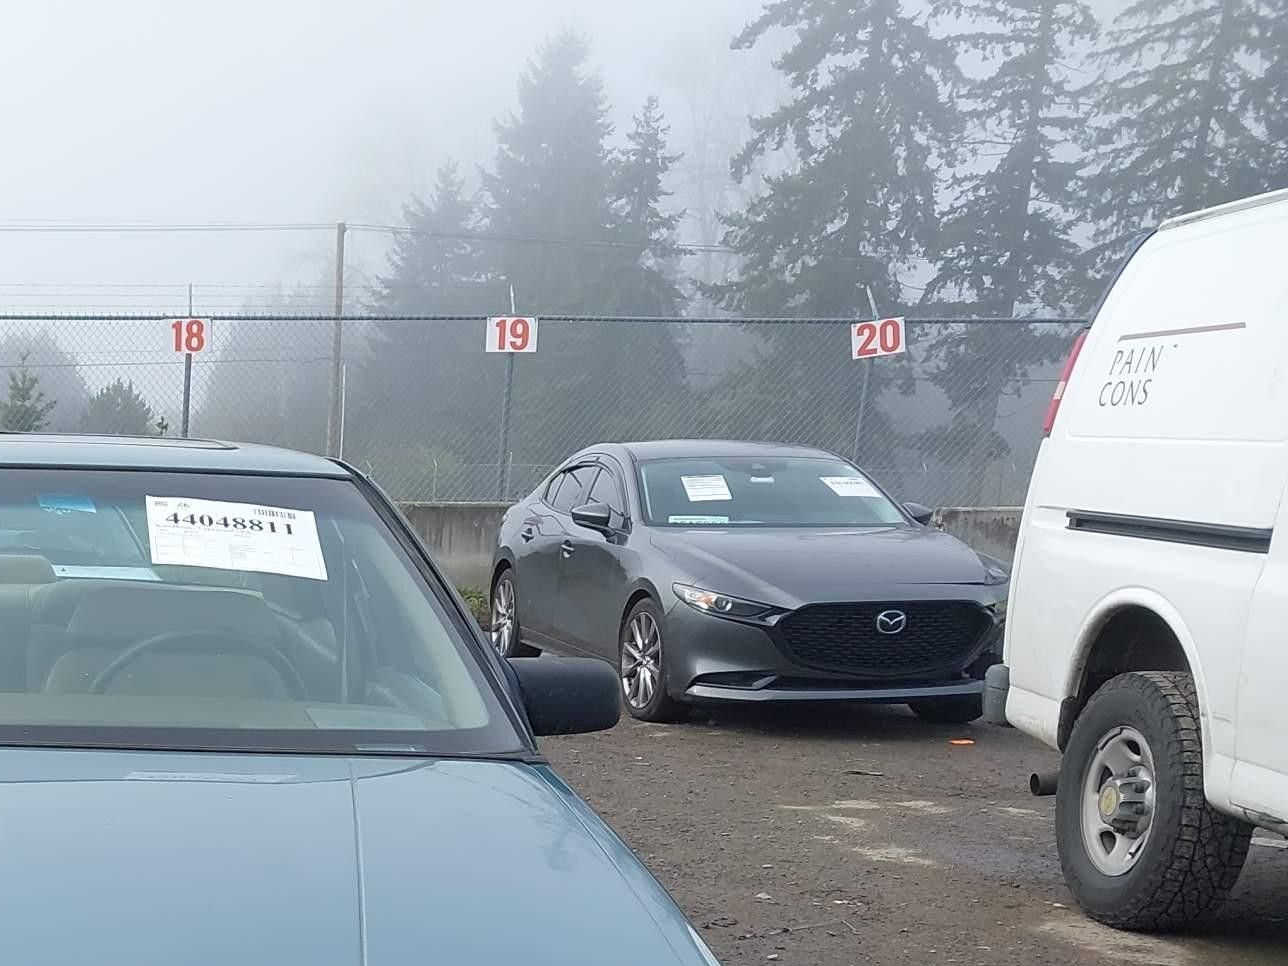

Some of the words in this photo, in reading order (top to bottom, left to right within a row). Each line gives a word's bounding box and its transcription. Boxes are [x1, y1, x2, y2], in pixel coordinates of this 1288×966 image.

[171, 319, 205, 352] 18
[495, 319, 530, 352] 19
[856, 319, 901, 357] 20
[1099, 379, 1152, 407] CONS
[165, 512, 294, 536] 44048811
